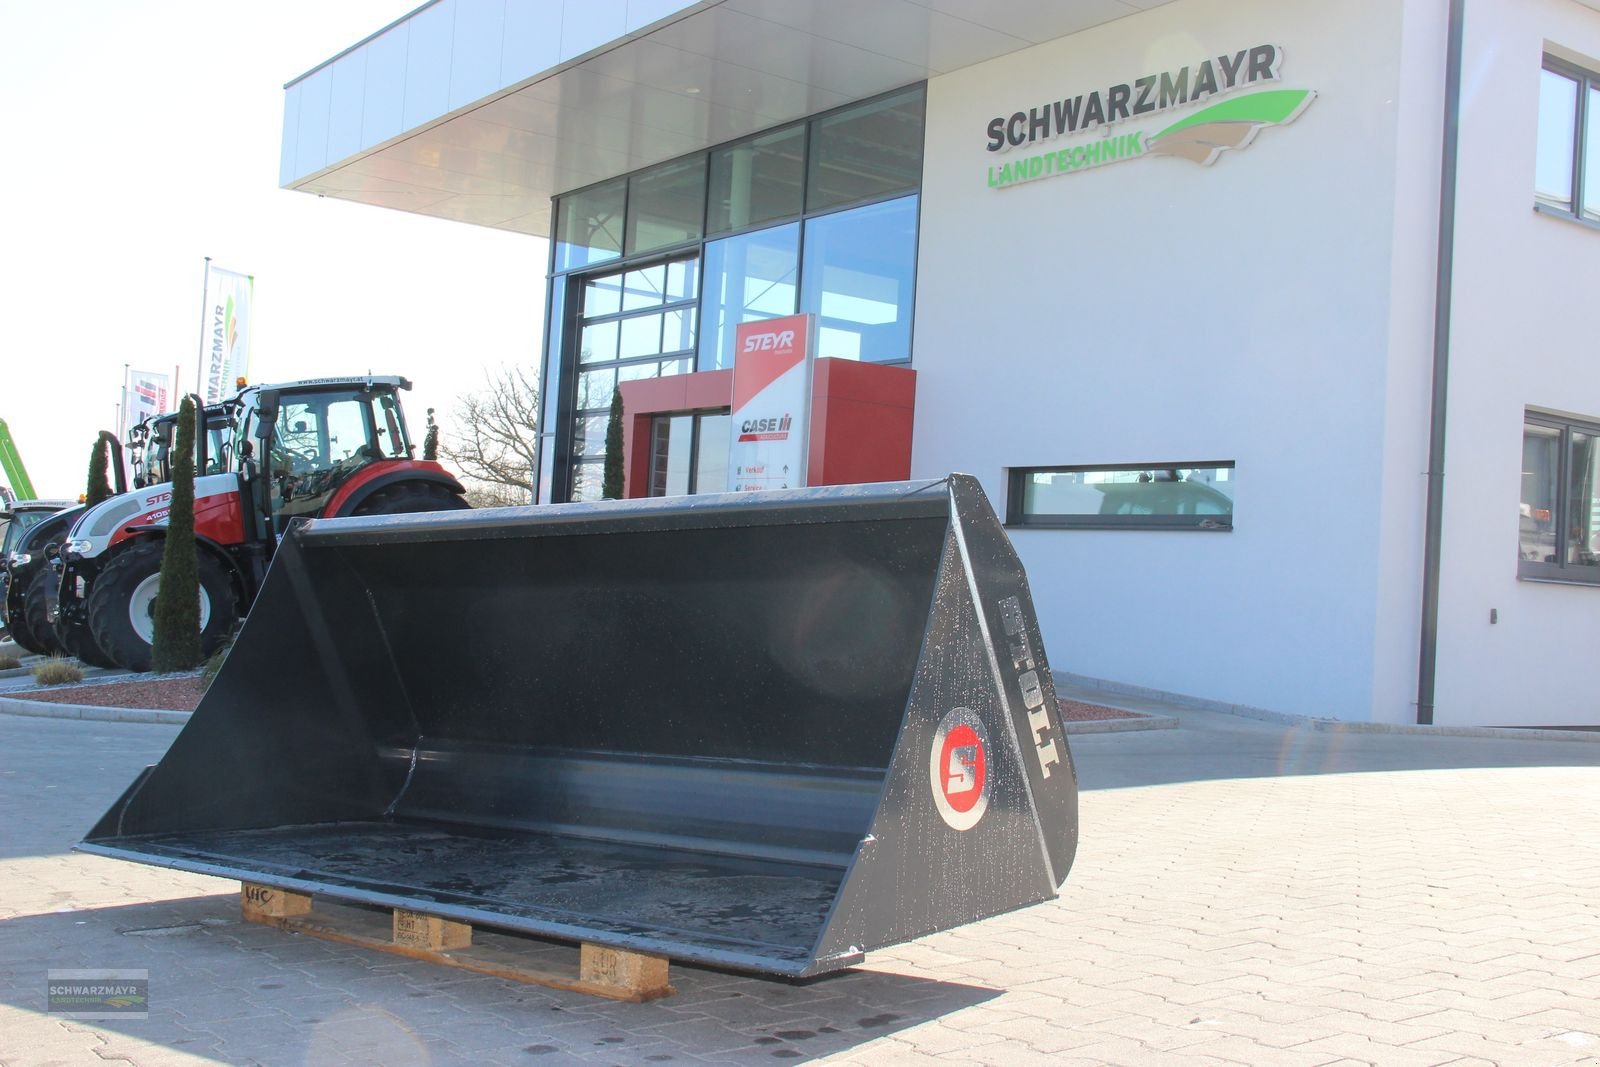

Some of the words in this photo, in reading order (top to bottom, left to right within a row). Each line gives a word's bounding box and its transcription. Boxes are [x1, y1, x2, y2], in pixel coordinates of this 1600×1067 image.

[986, 44, 1276, 152] SCHWARZMAYR
[987, 131, 1143, 188] LANDTECHNIK
[206, 304, 225, 405] WARZMAYR
[743, 330, 795, 353] STEYR
[741, 418, 777, 433] CASE
[146, 491, 173, 506] STE
[998, 595, 1060, 780] STOLL
